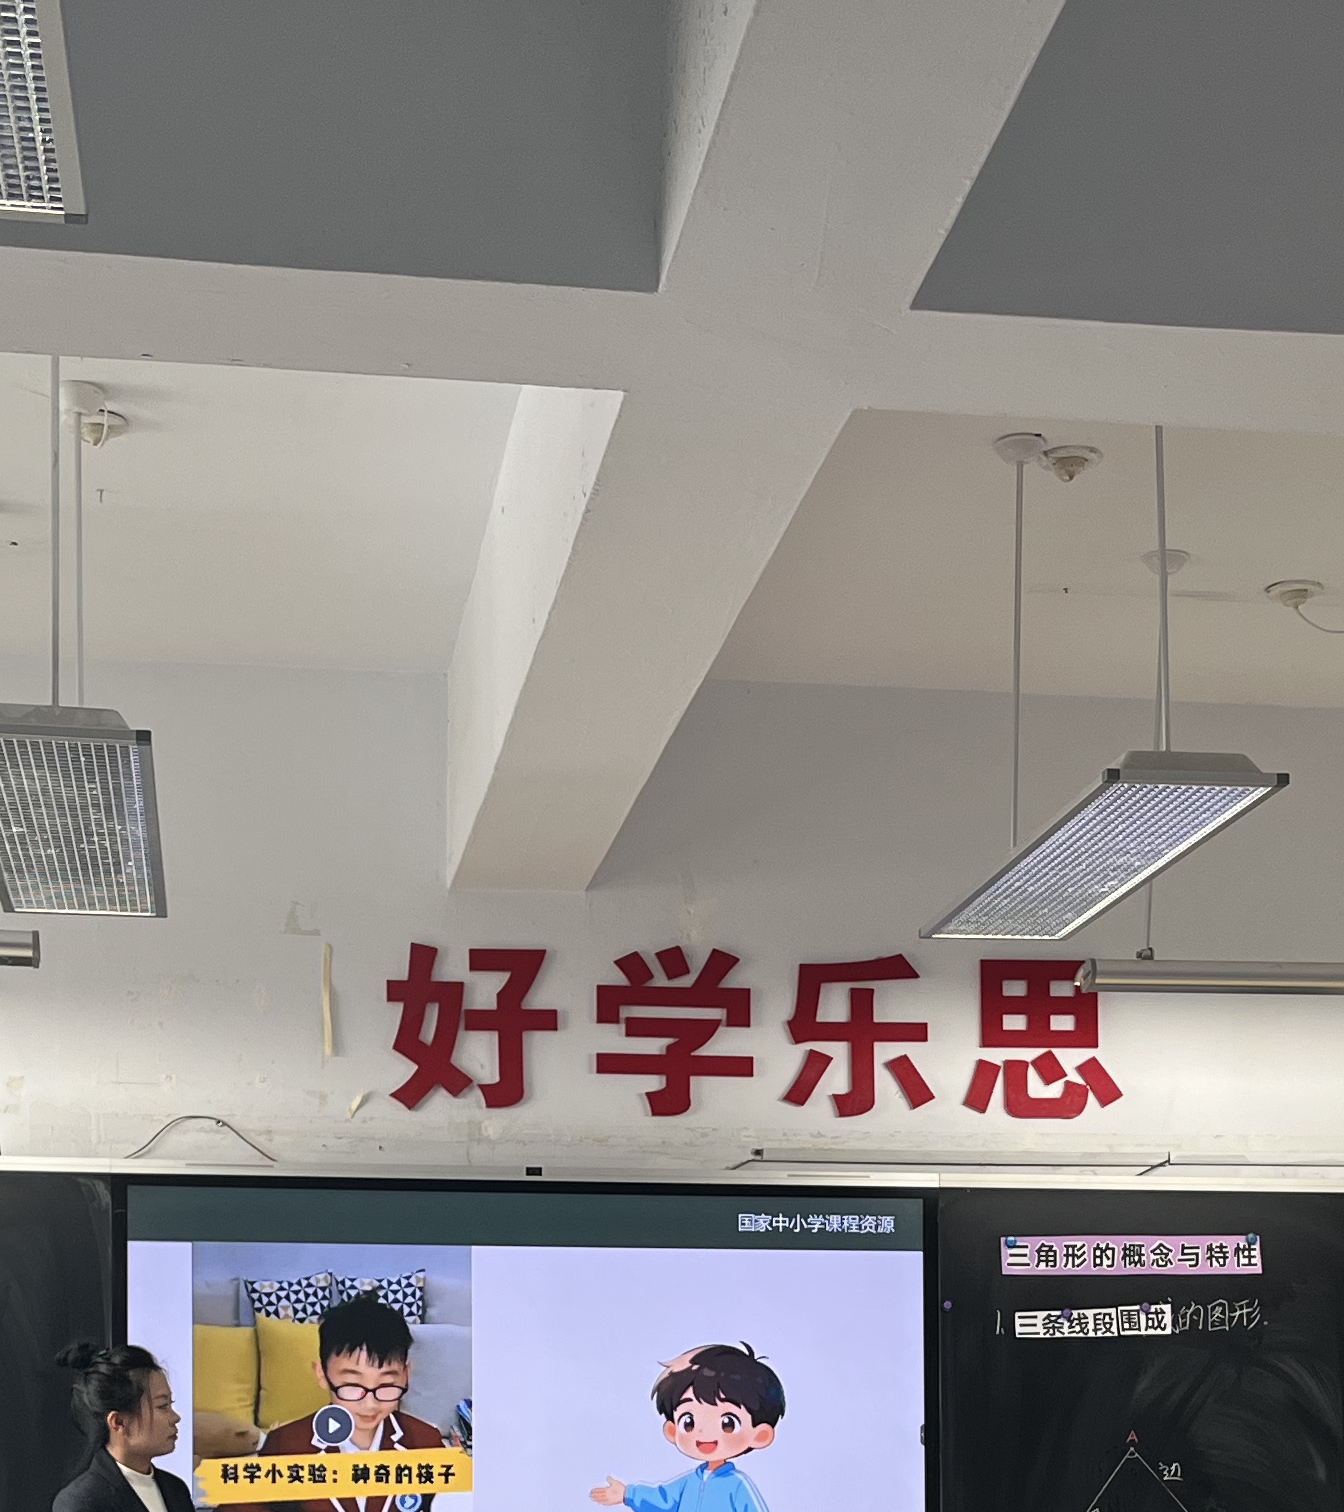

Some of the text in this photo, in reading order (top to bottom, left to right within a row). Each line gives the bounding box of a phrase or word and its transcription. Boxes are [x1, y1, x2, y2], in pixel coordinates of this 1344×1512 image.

[386, 942, 1124, 1119] 好学乐思
[738, 1213, 896, 1234] 国家中小学课程资源
[1006, 1242, 1259, 1269] 三角形的概念与特性
[1126, 1429, 1139, 1443] A
[220, 1462, 456, 1485] 科学小实验：神奇的筷子
[1158, 1461, 1184, 1482] 边
